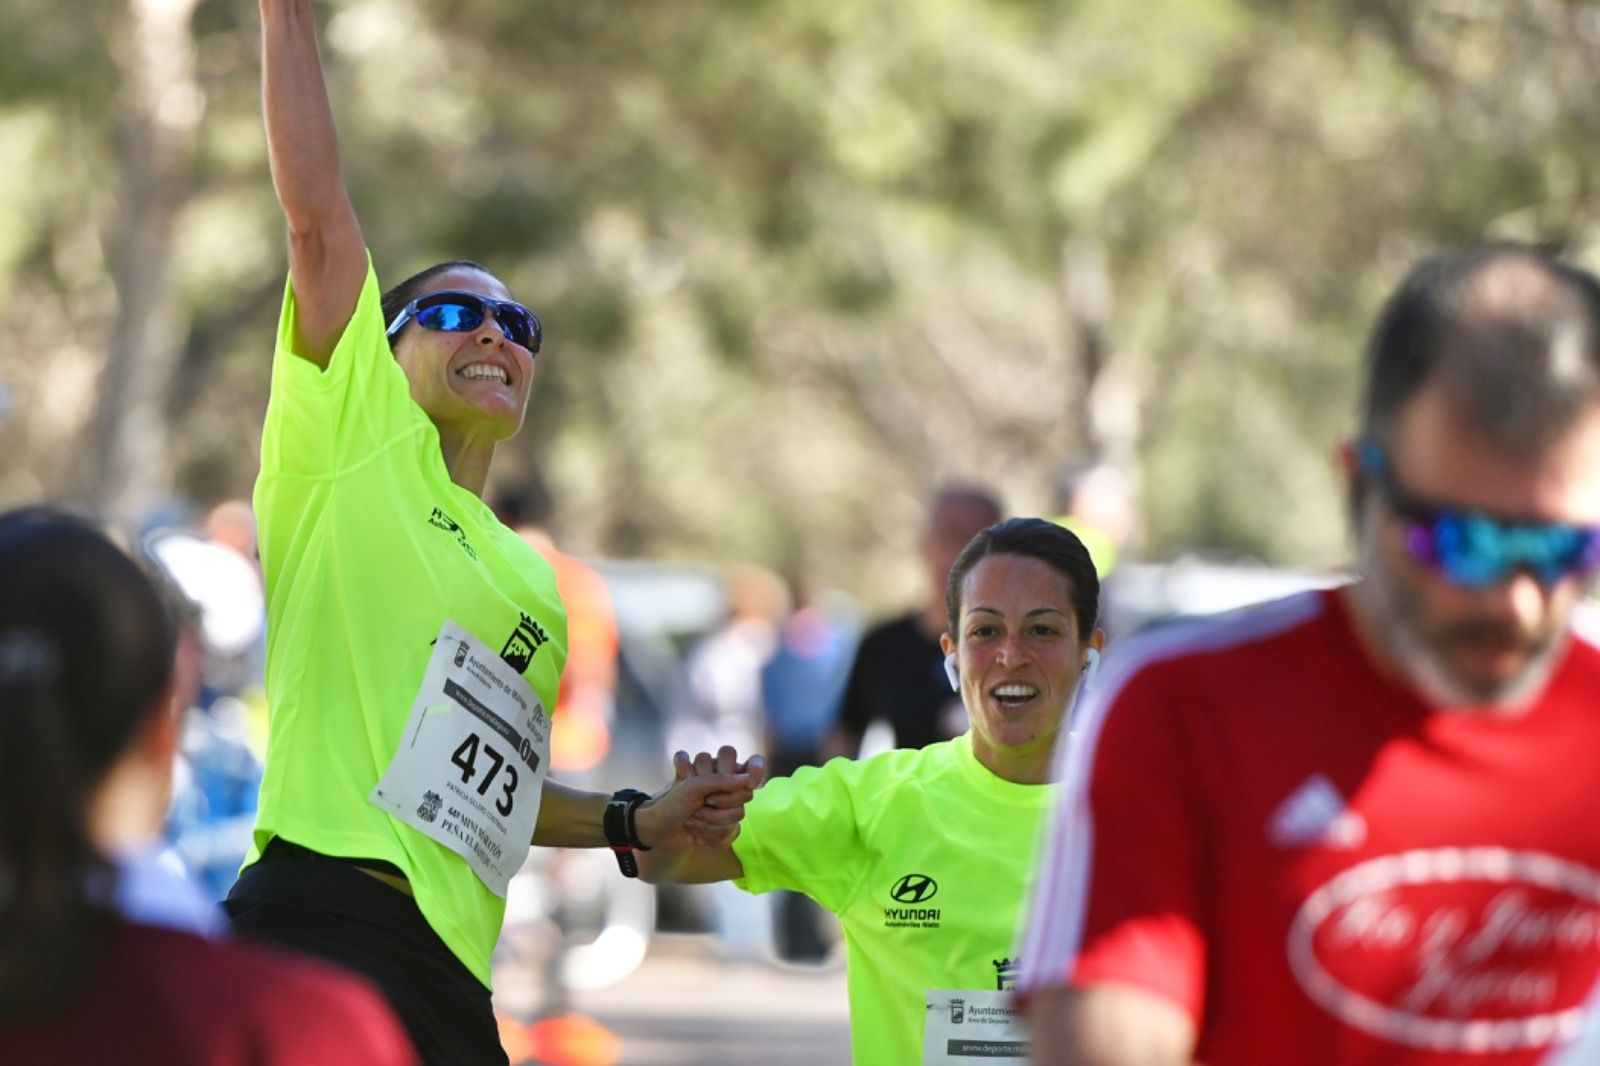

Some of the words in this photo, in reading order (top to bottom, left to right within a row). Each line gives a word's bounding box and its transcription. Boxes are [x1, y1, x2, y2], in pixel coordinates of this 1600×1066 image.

[468, 655, 504, 689] Ayuntamiento
[451, 732, 518, 817] 473
[441, 818, 464, 841] PEÑA
[464, 833, 474, 849] EL
[460, 813, 478, 835] MINI
